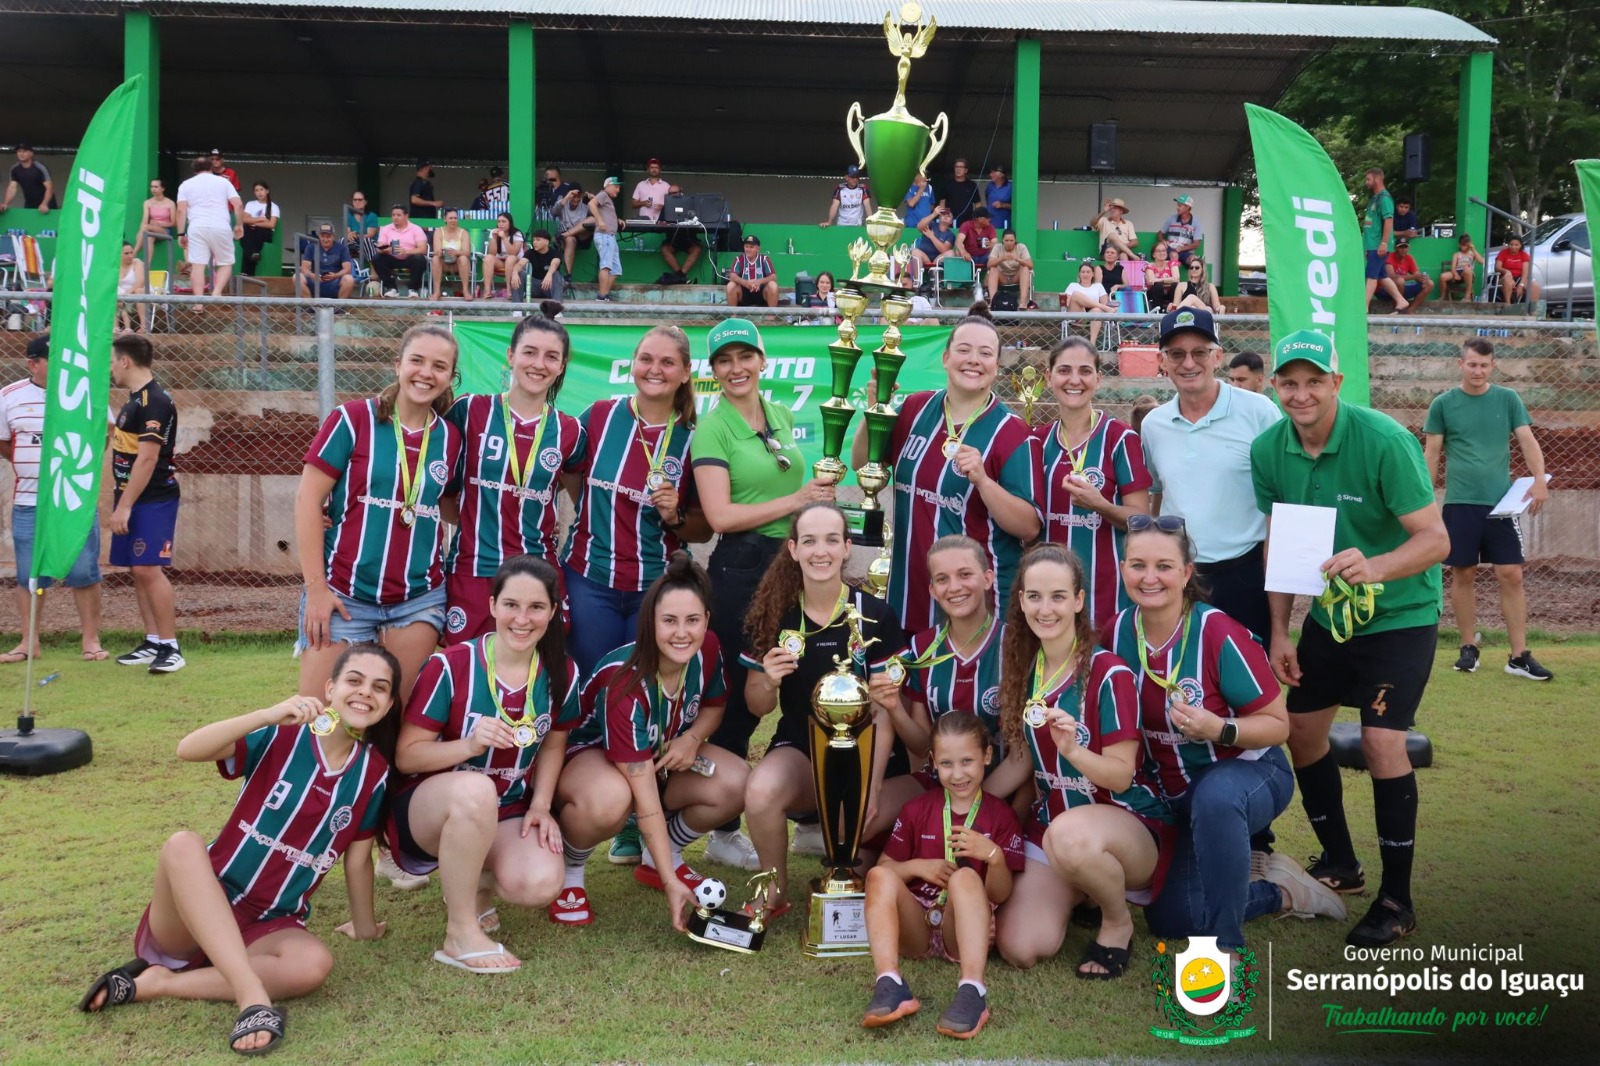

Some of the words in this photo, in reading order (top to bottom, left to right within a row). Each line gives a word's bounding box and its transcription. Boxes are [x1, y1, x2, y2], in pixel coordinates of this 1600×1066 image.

[1292, 196, 1338, 331] redi
[722, 329, 749, 337] Sicredi
[1292, 341, 1324, 352] Sicredi
[609, 357, 815, 384] CPEATO
[791, 385, 814, 411] 7
[478, 433, 504, 461] 19
[903, 434, 927, 460] 10
[1343, 494, 1362, 503] Sicredi
[1371, 689, 1387, 716] 4
